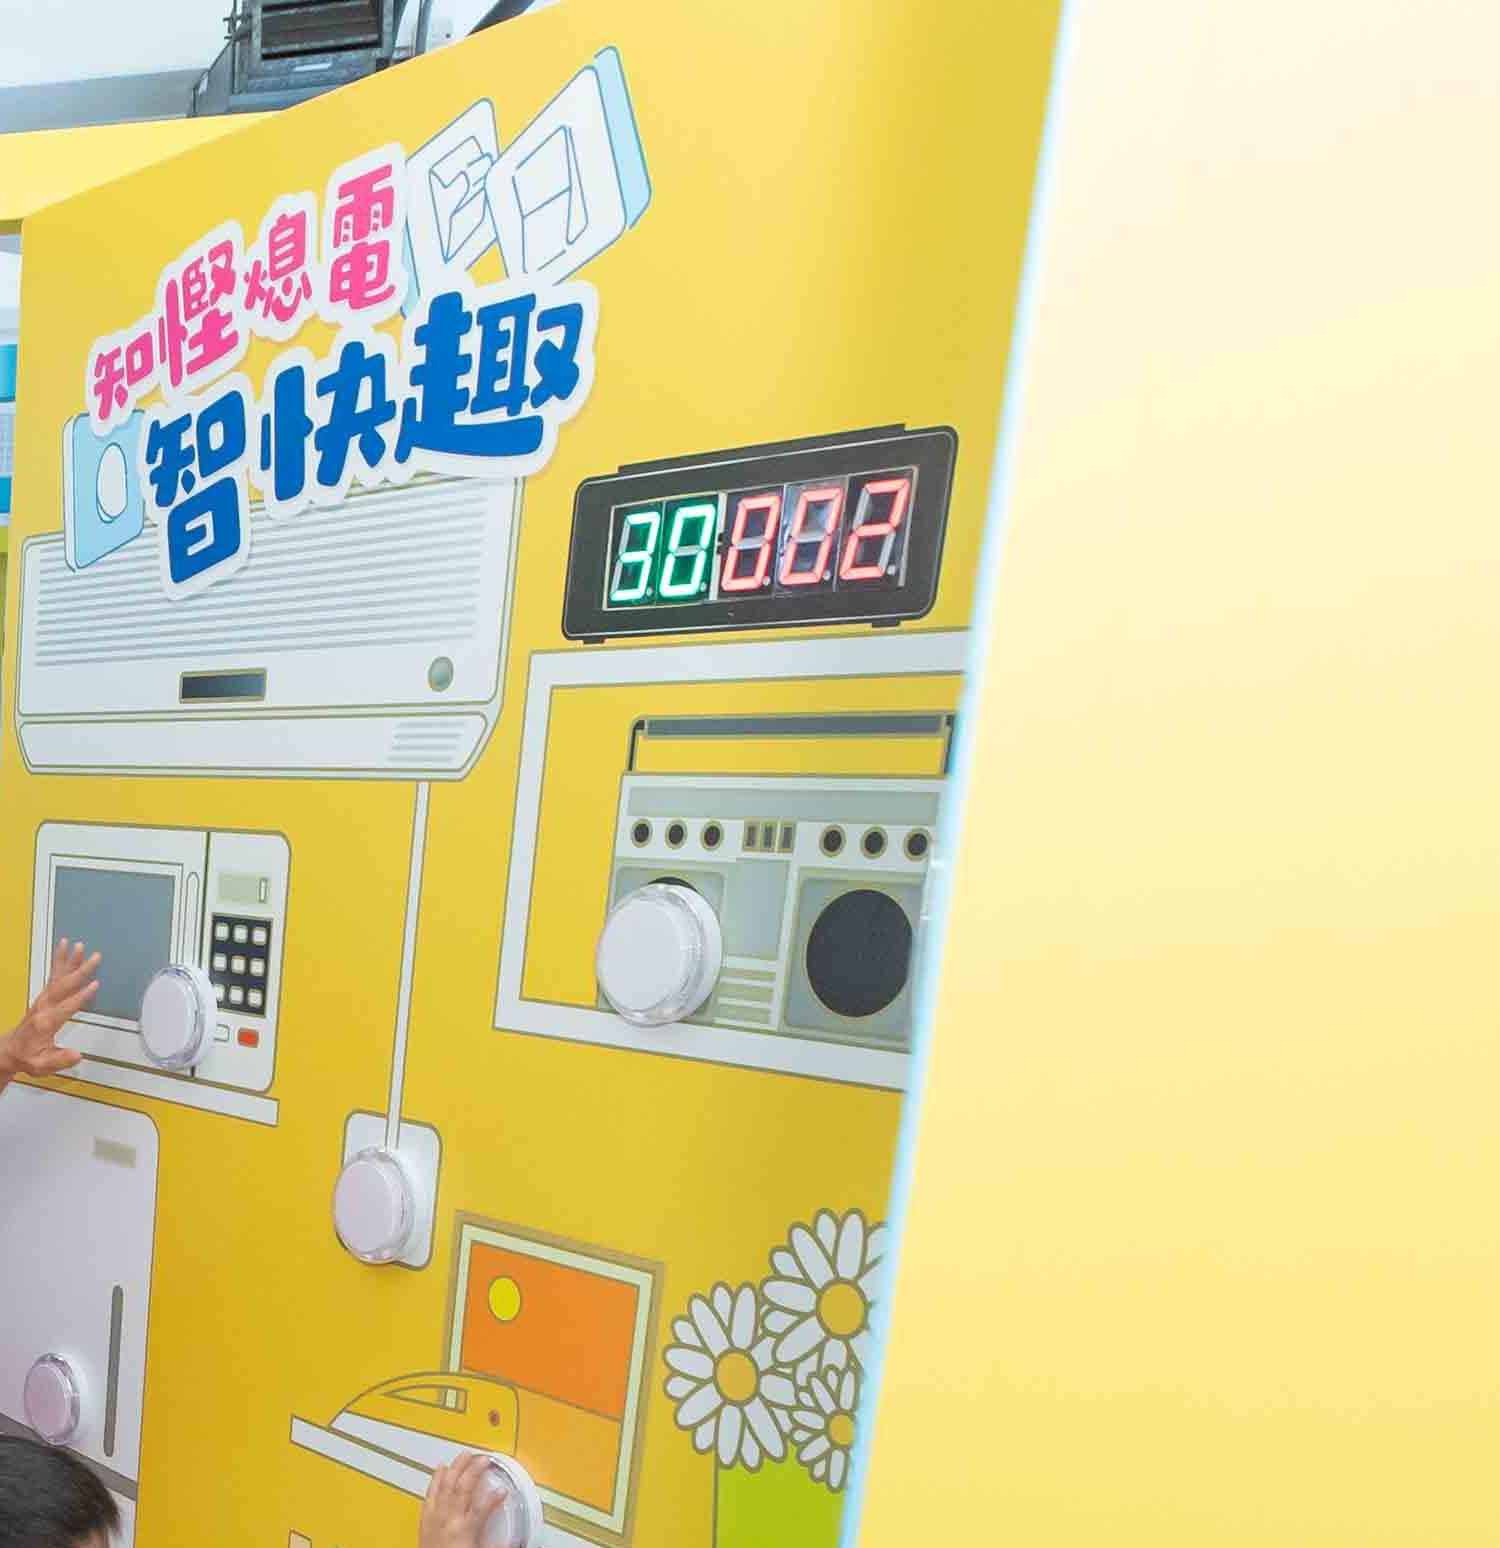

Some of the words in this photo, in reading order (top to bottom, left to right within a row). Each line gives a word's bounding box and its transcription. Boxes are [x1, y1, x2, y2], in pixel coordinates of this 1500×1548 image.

[93, 161, 398, 419] 知慳熄電
[144, 289, 584, 584] 智快趣
